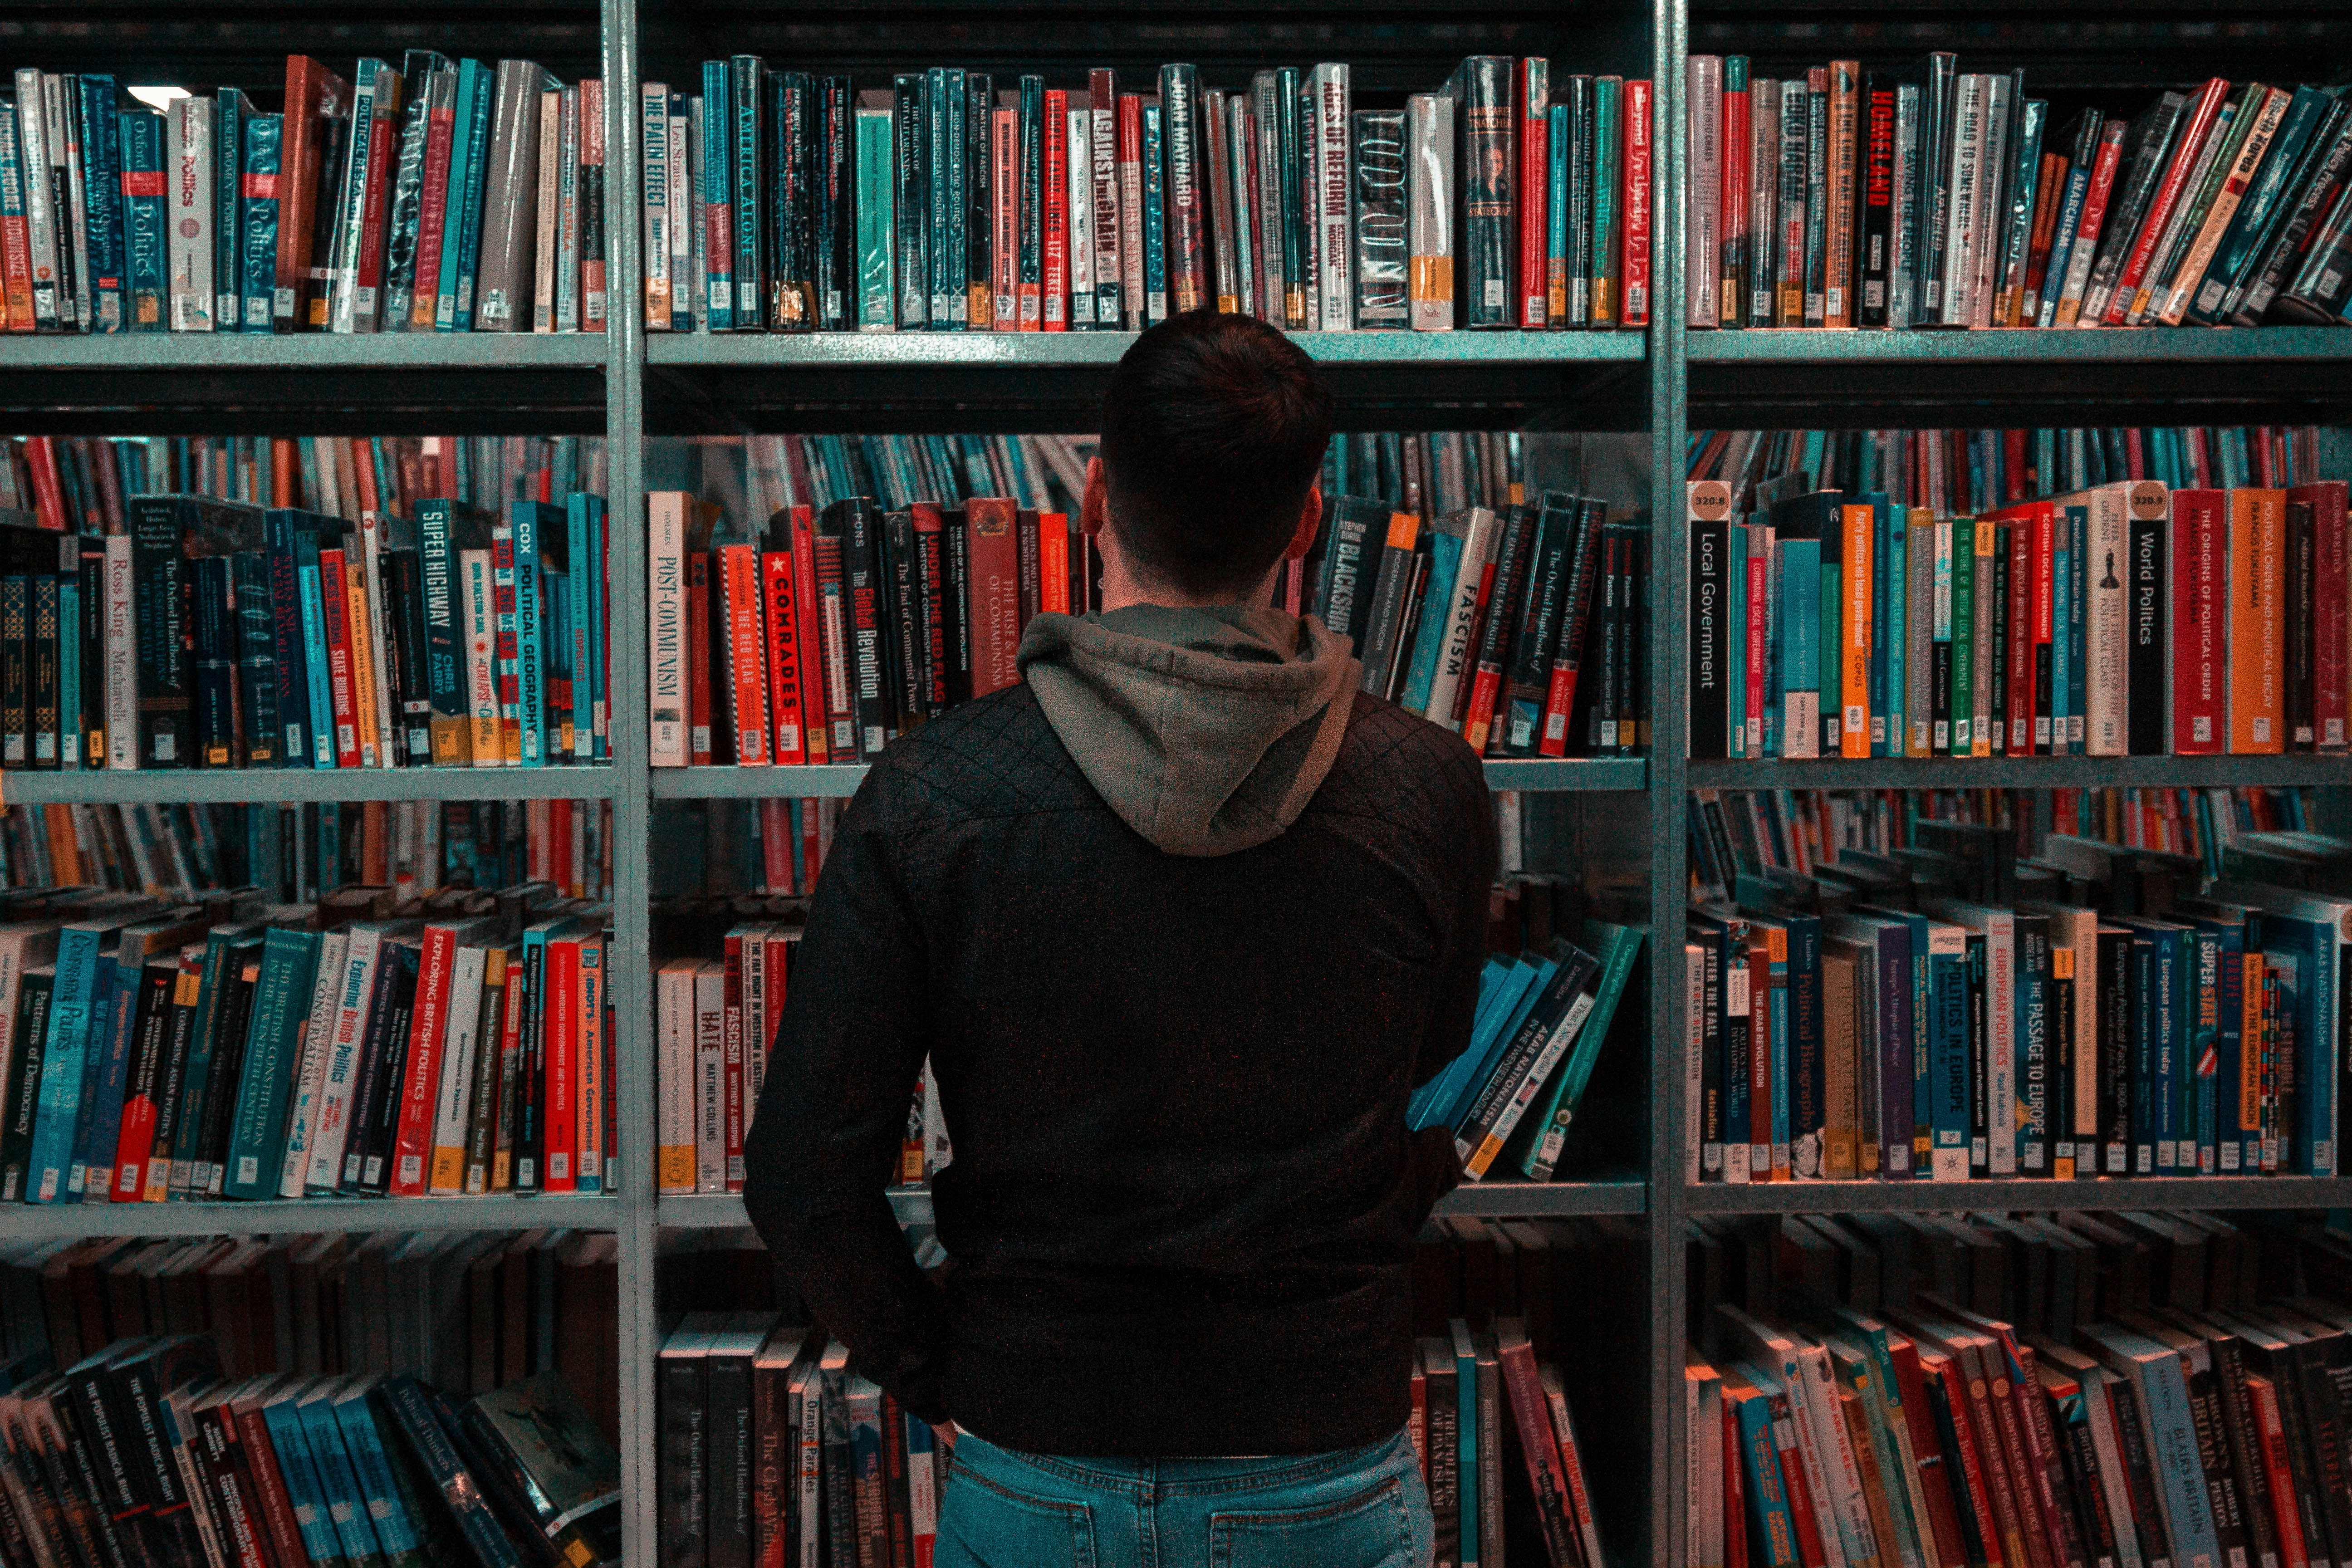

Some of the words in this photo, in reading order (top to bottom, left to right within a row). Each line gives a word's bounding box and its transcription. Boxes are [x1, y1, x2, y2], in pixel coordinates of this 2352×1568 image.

[646, 94, 663, 117] THE
[1171, 79, 1186, 125] JOAN
[1323, 82, 1345, 123] AGES
[1965, 88, 1978, 108] THE
[2259, 97, 2286, 132] North
[134, 121, 148, 168] Oxford
[645, 122, 664, 159] PALIN
[672, 125, 683, 145] Leo
[740, 106, 754, 187] AMERICA
[902, 96, 911, 181] TOTALITARIANISM
[1093, 110, 1113, 180] AGAINST
[1325, 127, 1345, 145] OF
[1964, 113, 1978, 140] ROAD
[672, 148, 683, 188] Strauss
[913, 160, 920, 171] OF
[979, 143, 986, 153] OF
[1174, 127, 1192, 206] MAYNARD
[1868, 90, 1893, 206] HOMELAND
[1962, 146, 1976, 158] TO
[2239, 134, 2269, 172] Korea
[648, 165, 665, 206] EFFECT
[1096, 182, 1108, 200] THE
[1325, 151, 1346, 216] REFORM
[1904, 148, 1916, 195] SAVING
[1903, 200, 1914, 229] THE
[1958, 163, 1973, 229] SOMEWHERE
[2059, 174, 2084, 247] ANARCHISM
[133, 204, 155, 276] Politics
[250, 207, 273, 279] Politics
[741, 197, 755, 257] ALONE
[1097, 201, 1115, 251] GRAIN
[8, 220, 27, 276] DOWNSIZE
[1901, 229, 1916, 272] PEOPLE
[422, 512, 446, 557] SUPER
[519, 523, 530, 554] COX
[853, 513, 863, 546] PONS
[2202, 509, 2210, 529] THE
[113, 559, 127, 594] Ross
[166, 558, 176, 579] The
[898, 563, 909, 582] The
[927, 535, 939, 588] UNDER
[1702, 534, 1715, 578] Local
[2140, 532, 2153, 580] World
[2202, 533, 2210, 582] ORIGINS
[167, 581, 177, 618] Oxford
[426, 561, 450, 627] HIGHWAY
[853, 571, 867, 587] The
[899, 585, 911, 606] End
[990, 576, 1000, 593] OF
[1003, 580, 1014, 603] THE
[1328, 543, 1361, 634] BLACKSHIR
[2202, 585, 2210, 600] OF
[112, 600, 127, 637] King
[521, 564, 534, 638] POLITICAL
[737, 610, 750, 629] THE
[854, 588, 874, 628] Global
[901, 608, 912, 619] of
[930, 594, 941, 624] THE
[2140, 587, 2153, 644] Politics
[657, 557, 677, 696] POST-COMMUNISM
[739, 633, 752, 653] RED
[776, 578, 796, 707] COMRADES
[931, 628, 942, 658] RED
[990, 598, 1002, 686] COMMUNISM
[1003, 610, 1014, 637] RISE
[1447, 587, 1477, 676] FASCISM
[1701, 584, 1715, 689] Government
[2202, 604, 2210, 658] POLITICAL
[168, 621, 180, 673] Handbook
[332, 650, 344, 675] STATE
[858, 630, 878, 698] Revolution
[902, 621, 914, 681] Communist
[1004, 642, 1014, 650] &
[113, 650, 126, 721] Machiavelli
[169, 676, 181, 688] of
[433, 653, 443, 694] PARRY
[444, 654, 454, 691] CHRIS
[740, 657, 754, 684] FLAG
[933, 662, 945, 701] FLAG
[1004, 653, 1016, 681] FALL
[2202, 662, 2210, 700] ORDER
[334, 677, 349, 715] BUILDING
[524, 644, 537, 732] GEOGRAPHY
[906, 682, 917, 713] Power
[343, 960, 367, 1007] Exploring
[424, 935, 443, 1000] EXPLORING
[1707, 947, 1716, 981] AFTER
[1995, 949, 2008, 1012] EUROPEAN
[2161, 959, 2171, 1004] European
[586, 979, 594, 1019] IDIOT'S
[1707, 986, 1716, 1007] THE
[1798, 973, 1812, 1040] Political
[1948, 963, 1961, 1027] POLITICS
[2030, 981, 2041, 998] THE
[31, 991, 48, 1045] Patterns
[339, 1010, 358, 1043] British
[419, 1003, 435, 1047] BRITISH
[702, 1012, 720, 1052] HATE
[727, 1006, 739, 1063] FASCISM
[1528, 1024, 1548, 1053] ARAB
[1707, 1011, 1716, 1036] FALL
[2029, 1003, 2044, 1062] PASSAGE
[2160, 1008, 2170, 1044] politics
[29, 1047, 39, 1060] of
[1949, 1034, 1961, 1049] IN
[1996, 1016, 2008, 1065] POLITICS
[2160, 1047, 2170, 1074] today
[333, 1045, 351, 1083] Politics
[414, 1050, 430, 1099] POLITICS
[706, 1063, 715, 1104] MATTHEW
[1950, 1056, 1963, 1112] EUROPE
[2029, 1065, 2043, 1079] TO
[15, 1063, 37, 1136] Democracy
[1481, 1055, 1530, 1126] NATIONALISM
[1798, 1045, 1814, 1129] Biography
[585, 1088, 594, 1152] Governmen
[706, 1107, 715, 1141] COLLINS
[2029, 1083, 2044, 1135] EUROPE
[130, 1378, 140, 1393] THE
[135, 1396, 152, 1435] POPULIST
[148, 1438, 164, 1475] RADICAL
[160, 1477, 174, 1501] RIGHT
[763, 1432, 777, 1448] The
[805, 1401, 816, 1442] Orange
[1446, 1412, 1455, 1438] THE
[2192, 1397, 2216, 1469] BRITAIN
[763, 1467, 777, 1506] Clash
[805, 1448, 817, 1494] Parades
[1446, 1444, 1456, 1506] POLITICS
[2172, 1427, 2190, 1475] BLAIR'S
[2183, 1480, 2204, 1533] BRITAIN
[763, 1512, 777, 1562] Within
